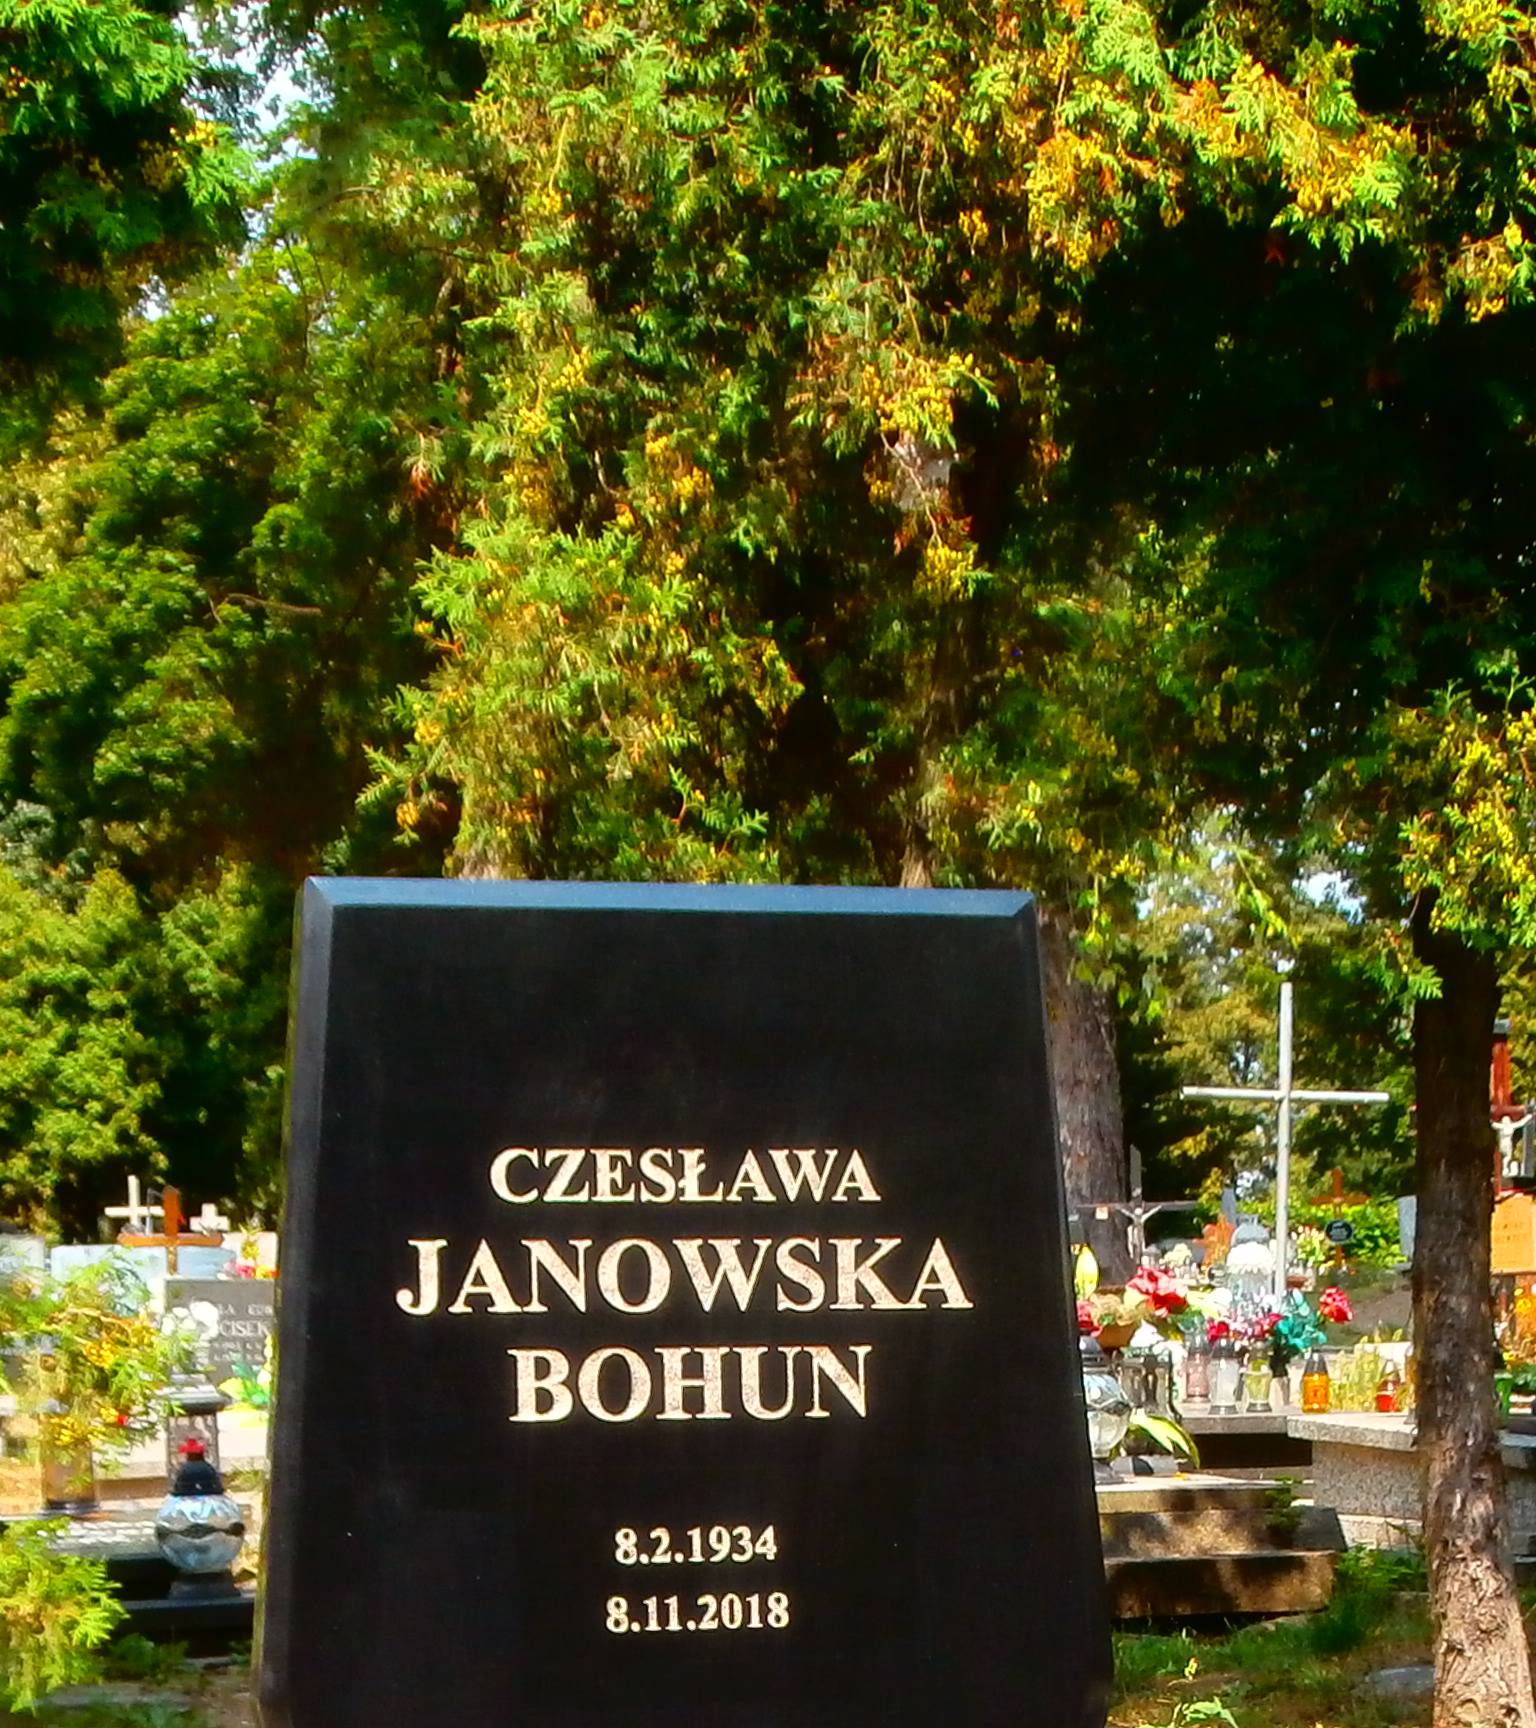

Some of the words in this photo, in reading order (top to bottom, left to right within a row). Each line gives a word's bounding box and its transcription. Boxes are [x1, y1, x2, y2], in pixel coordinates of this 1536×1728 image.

[490, 1147, 882, 1204] CZESŁAWA
[395, 1236, 974, 1316] JANOWSKA
[506, 1344, 873, 1423] BOHUN
[614, 1524, 778, 1565] 8.2.1934
[606, 1591, 790, 1634] 8.11.2018
